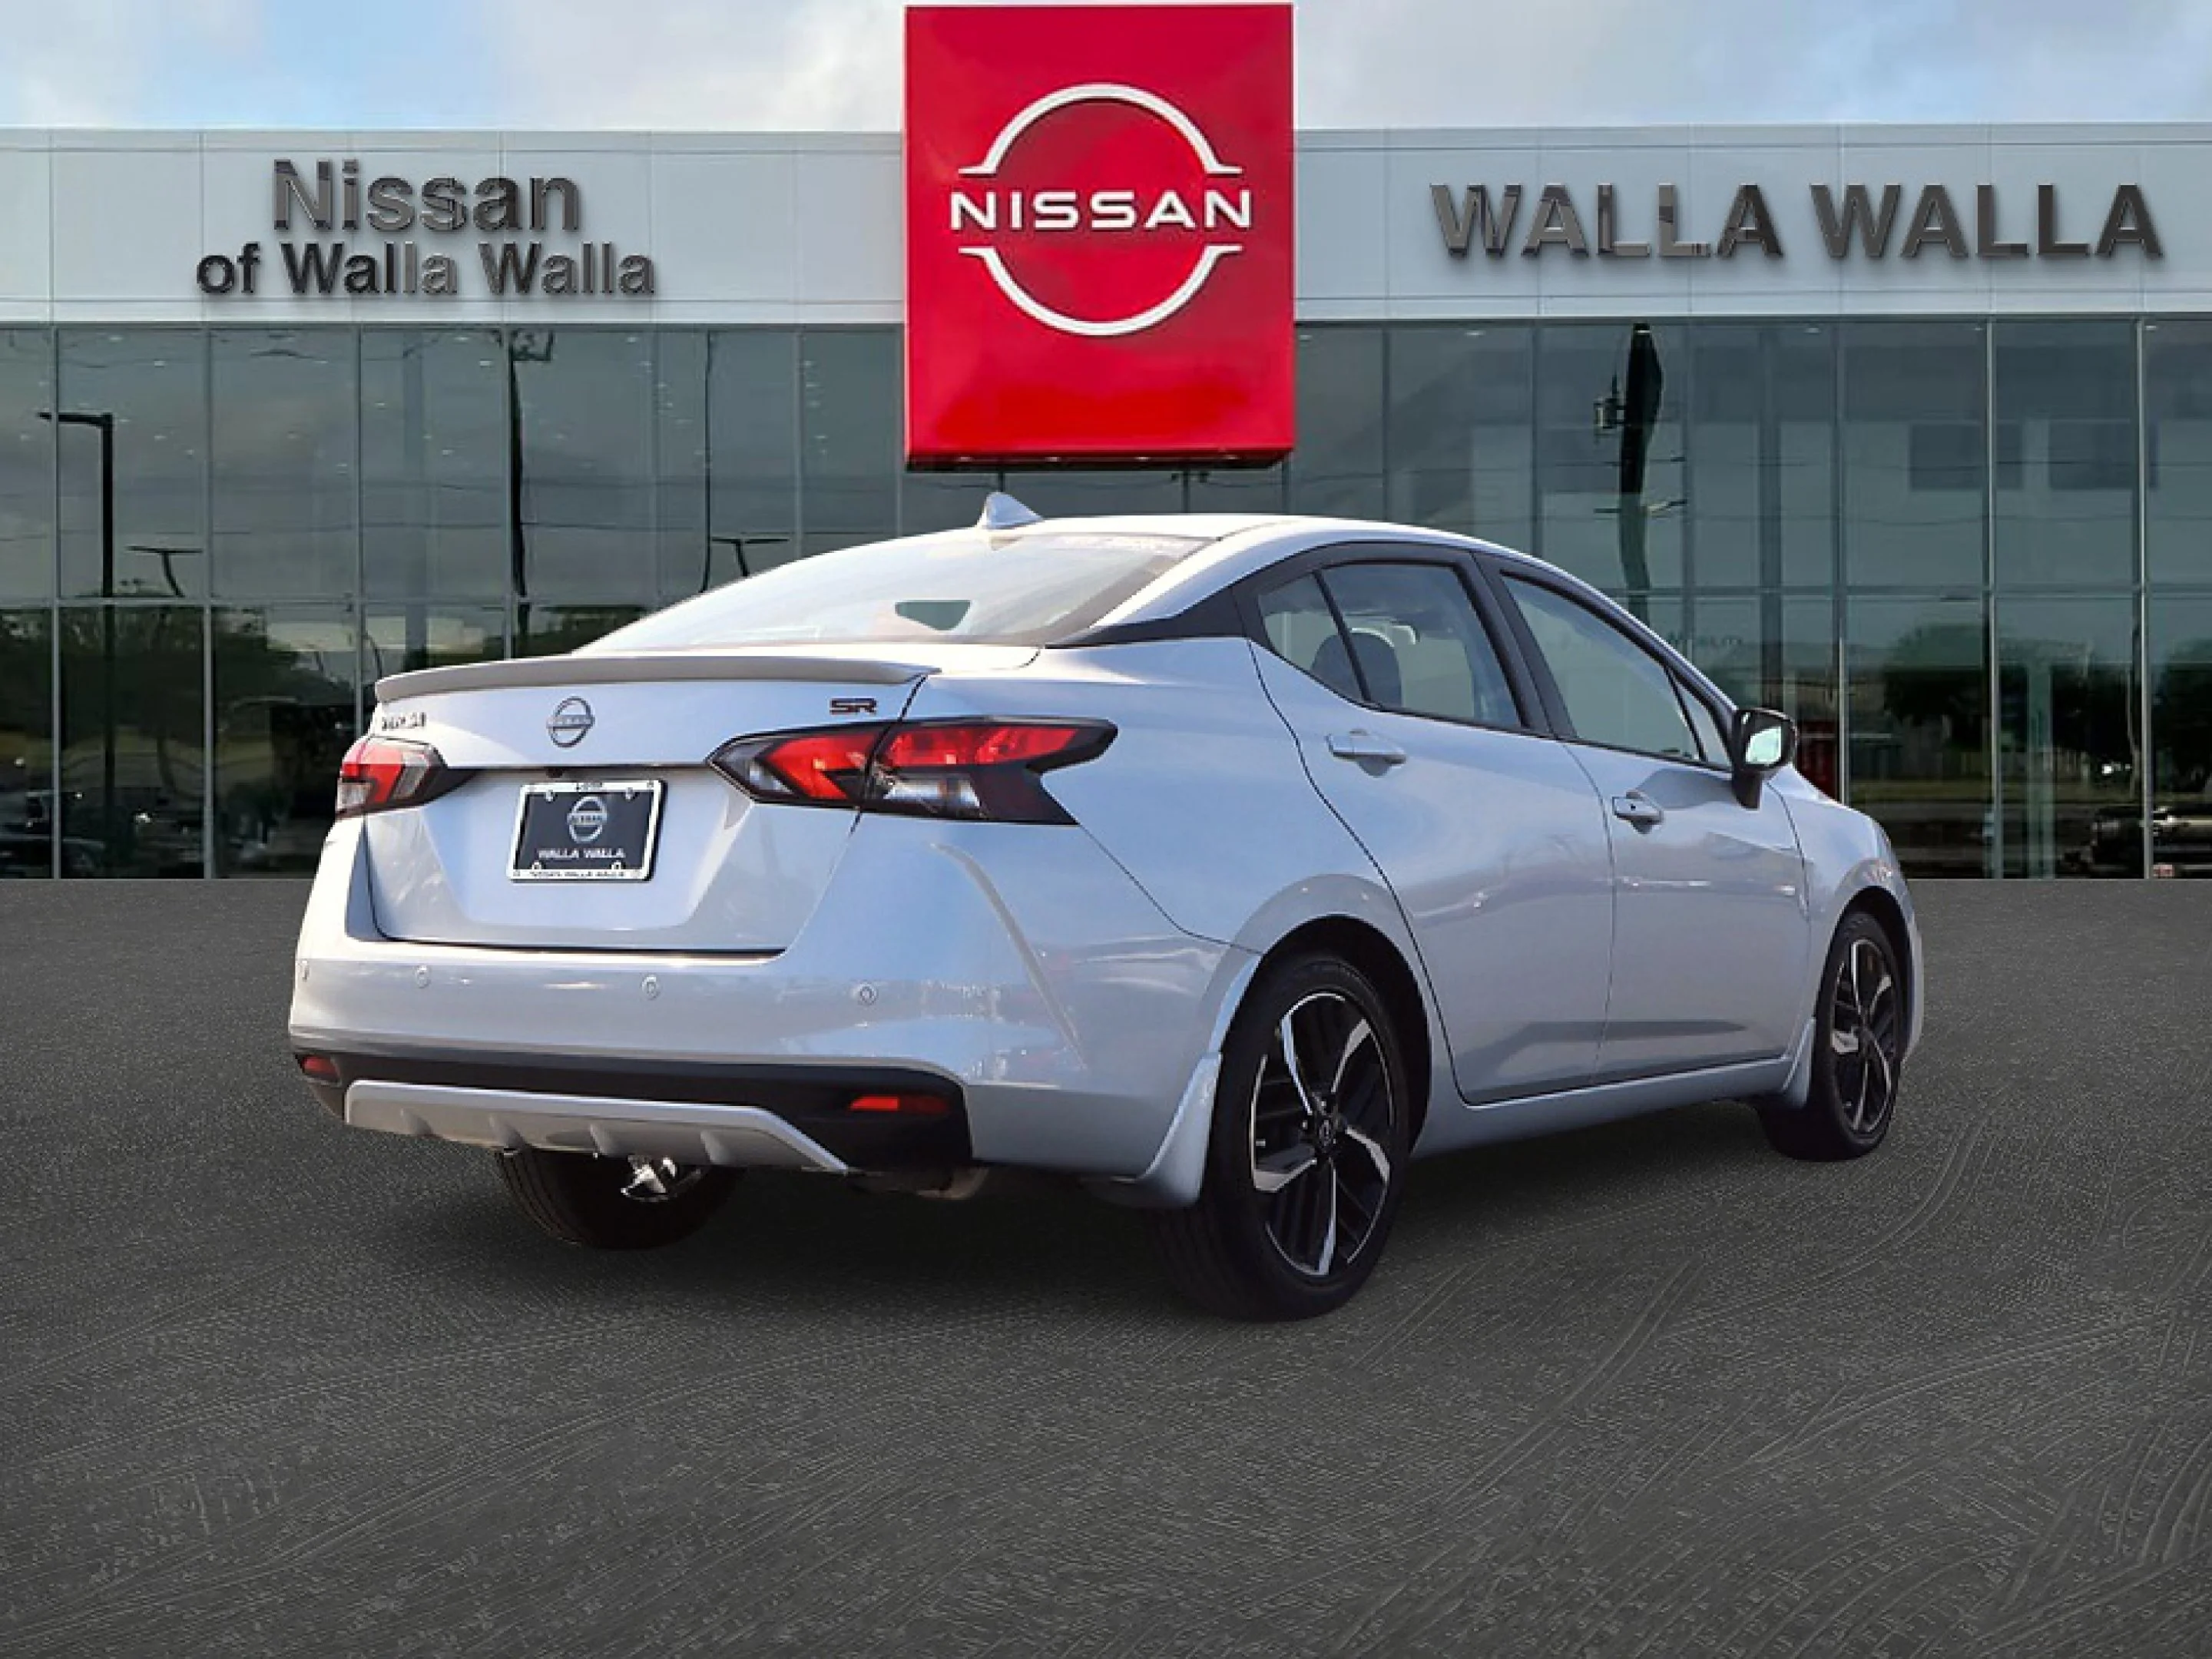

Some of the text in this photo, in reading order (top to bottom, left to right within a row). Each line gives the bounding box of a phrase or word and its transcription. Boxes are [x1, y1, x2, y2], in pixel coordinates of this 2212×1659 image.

[273, 158, 581, 230] Nissan
[950, 190, 1251, 230] NISSAN
[1429, 182, 2164, 258] WALLA WALLA
[196, 241, 655, 294] of Walla Walla
[830, 697, 876, 715] SR
[538, 847, 626, 859] WALLA WALLA
